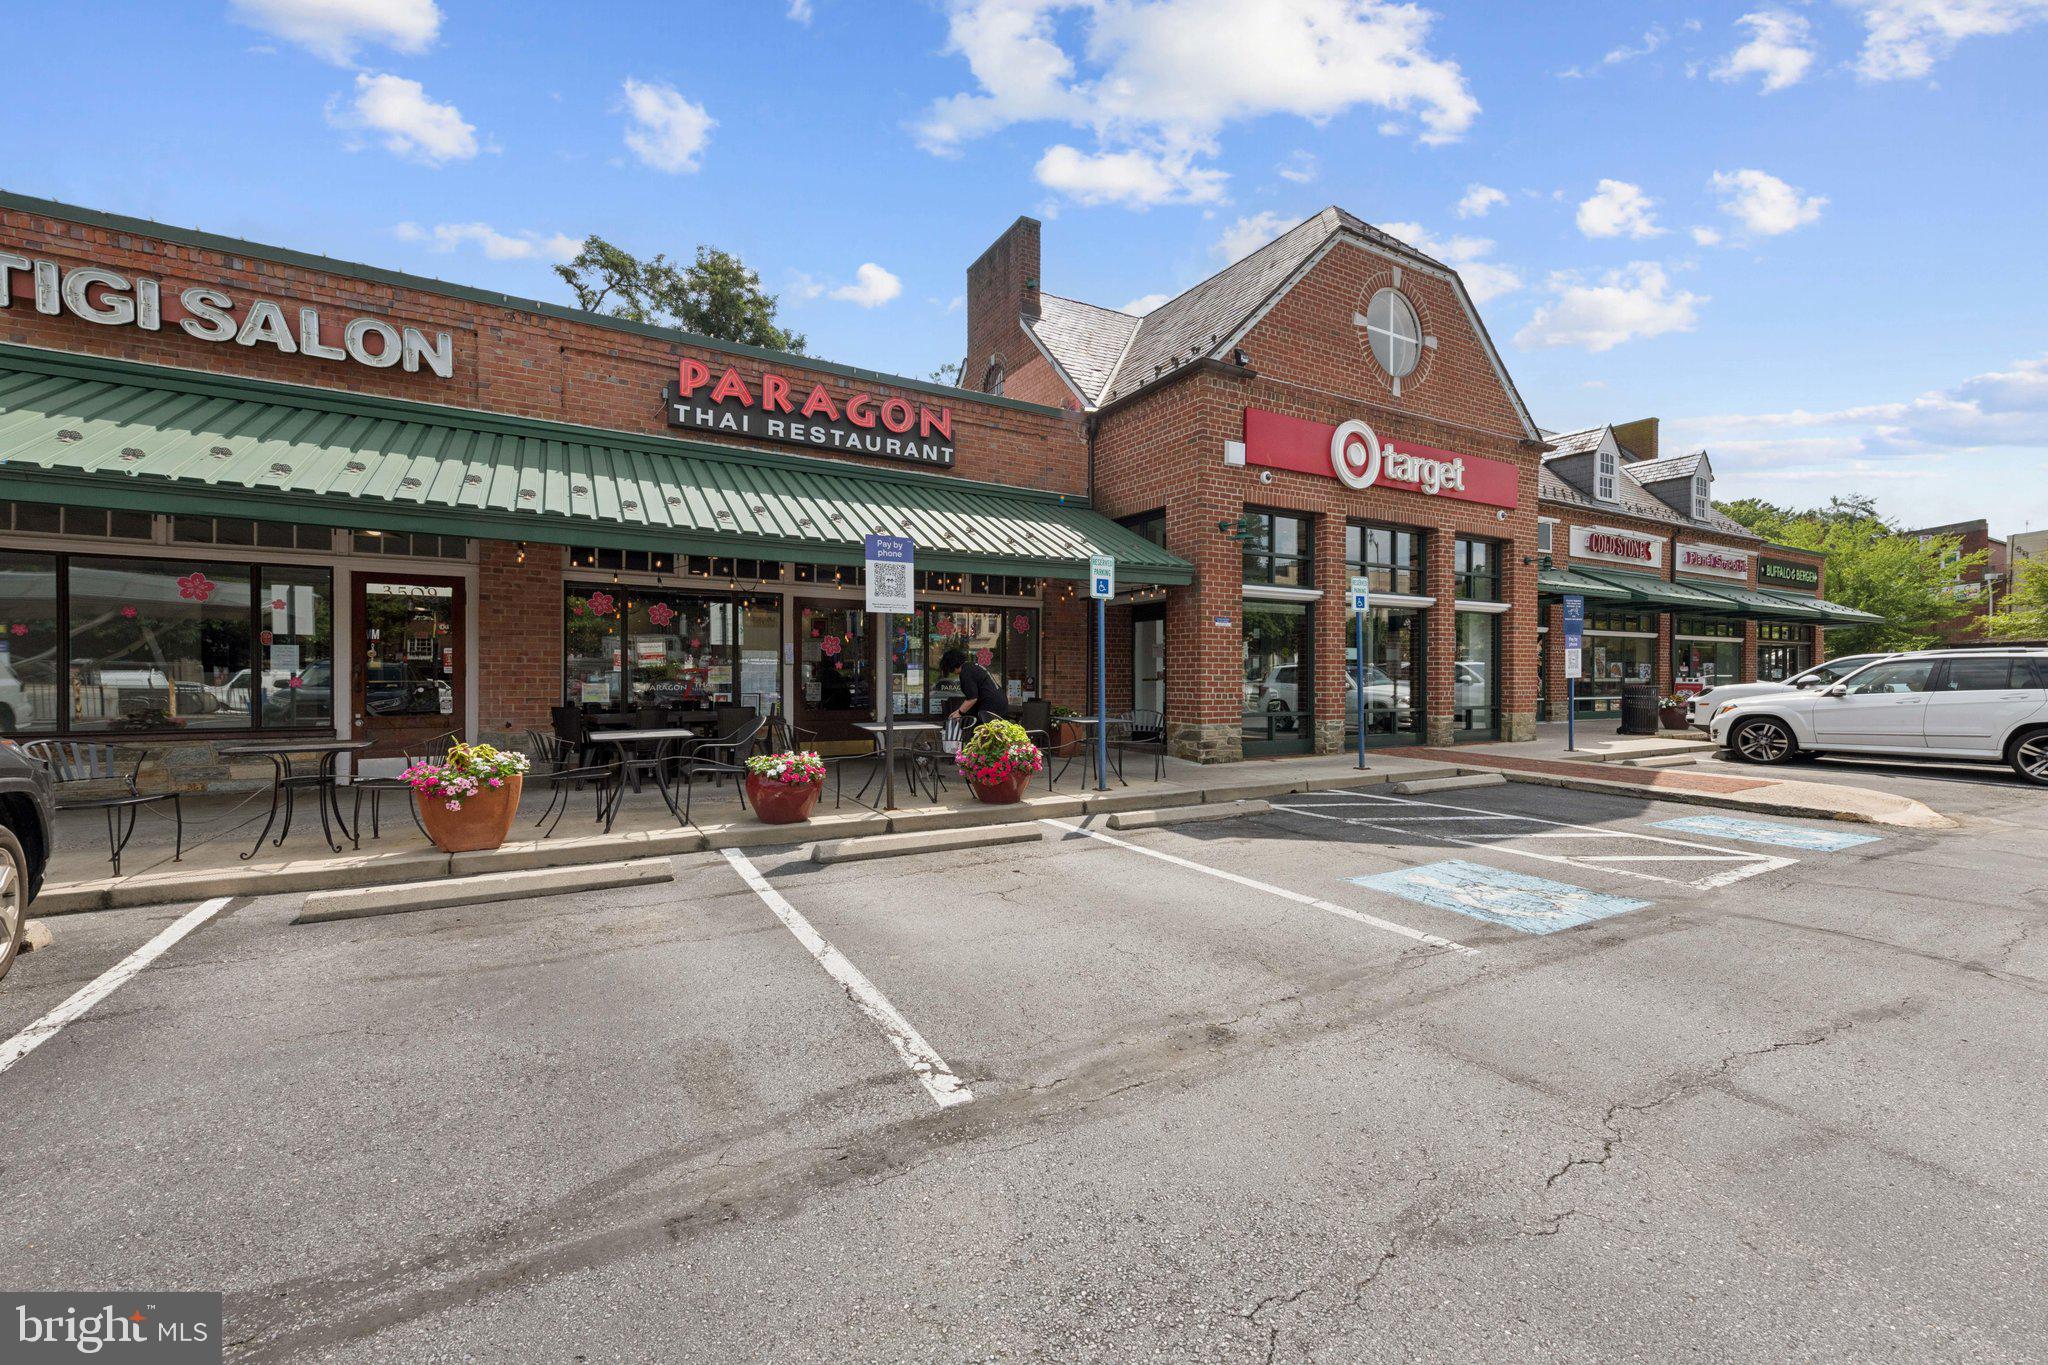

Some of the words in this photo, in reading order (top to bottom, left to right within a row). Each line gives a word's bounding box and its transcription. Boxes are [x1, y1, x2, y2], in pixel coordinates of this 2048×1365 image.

[179, 287, 454, 379] SALON
[678, 357, 952, 442] PARAGON
[673, 404, 750, 432] THAI
[767, 419, 954, 463] RESTAURANT
[1382, 443, 1465, 495] target
[877, 540, 891, 549] Pay
[893, 541, 903, 550] by
[878, 549, 902, 557] phone
[1592, 533, 1616, 554] COLD
[1617, 538, 1645, 558] STONE
[1766, 564, 1791, 579] BUFFALO
[941, 684, 961, 692] PARAG
